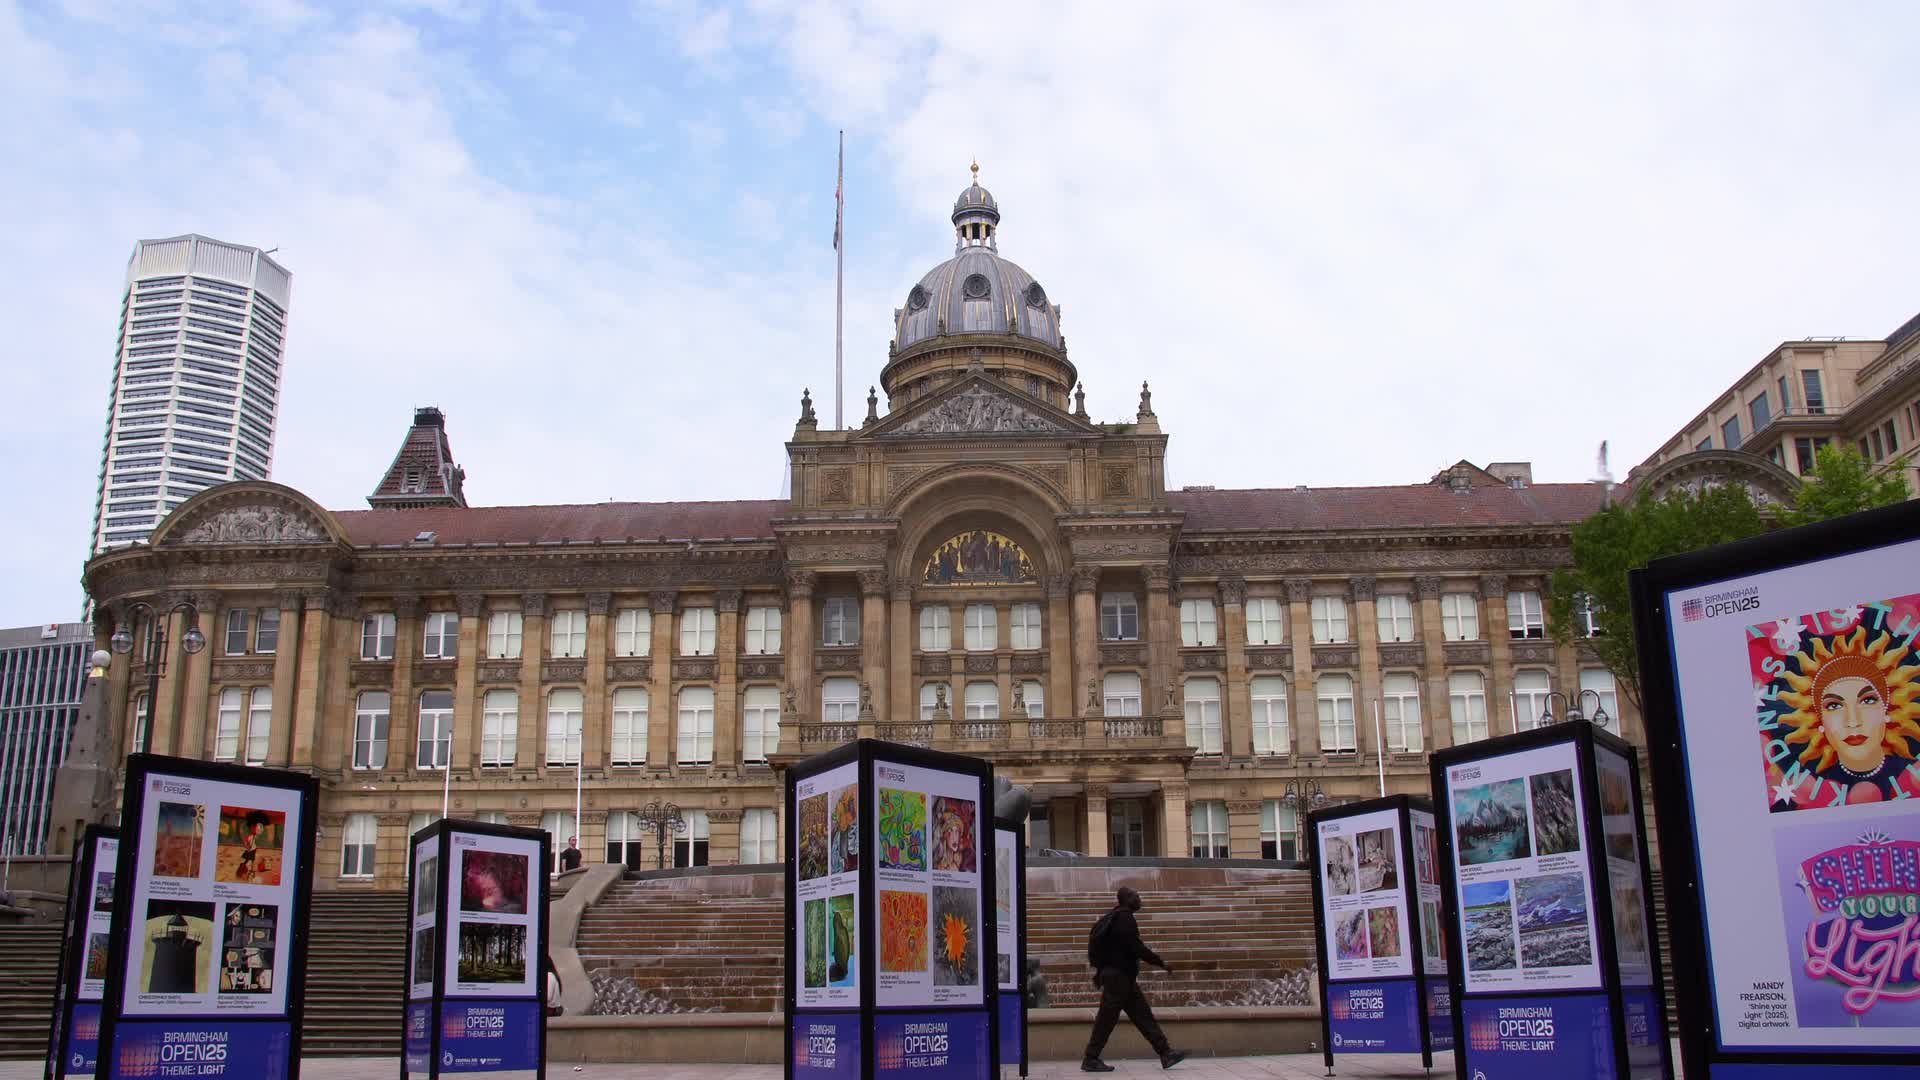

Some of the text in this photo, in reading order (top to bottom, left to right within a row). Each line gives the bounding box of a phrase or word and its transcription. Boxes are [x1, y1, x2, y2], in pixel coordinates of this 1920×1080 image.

[1705, 586, 1759, 604] BIRMINGHAM
[1705, 596, 1760, 618] OPEN25
[1811, 847, 1920, 911] SHIN
[1804, 915, 1920, 1015] Ligh
[1753, 981, 1784, 990] MANDY
[1350, 988, 1383, 998] BIRMINGHAM
[1740, 992, 1787, 1001] FREARSON,
[1350, 997, 1384, 1010] OPEN25
[1771, 1003, 1787, 1011] your
[467, 1008, 504, 1016] BIRMINGHAM
[1351, 1011, 1384, 1020] THEME: LIGHT
[1499, 1008, 1552, 1019] BIRMINGHAM
[466, 1016, 504, 1029] OPEN25
[905, 1023, 948, 1034] BIRMINGHAM
[1499, 1019, 1554, 1037] OPEN25
[1738, 1021, 1761, 1030] Digital
[163, 1031, 228, 1043] BIRMINGHAM
[487, 1030, 504, 1038] LIGHT
[809, 1036, 836, 1054] OPEN25
[904, 1035, 948, 1054] OPEN25
[1501, 1041, 1554, 1051] THEME: LIGHT
[161, 1044, 227, 1062] OPEN25
[906, 1056, 948, 1068] THEME: LIGHT
[160, 1065, 226, 1077] THEME: LIGHT
